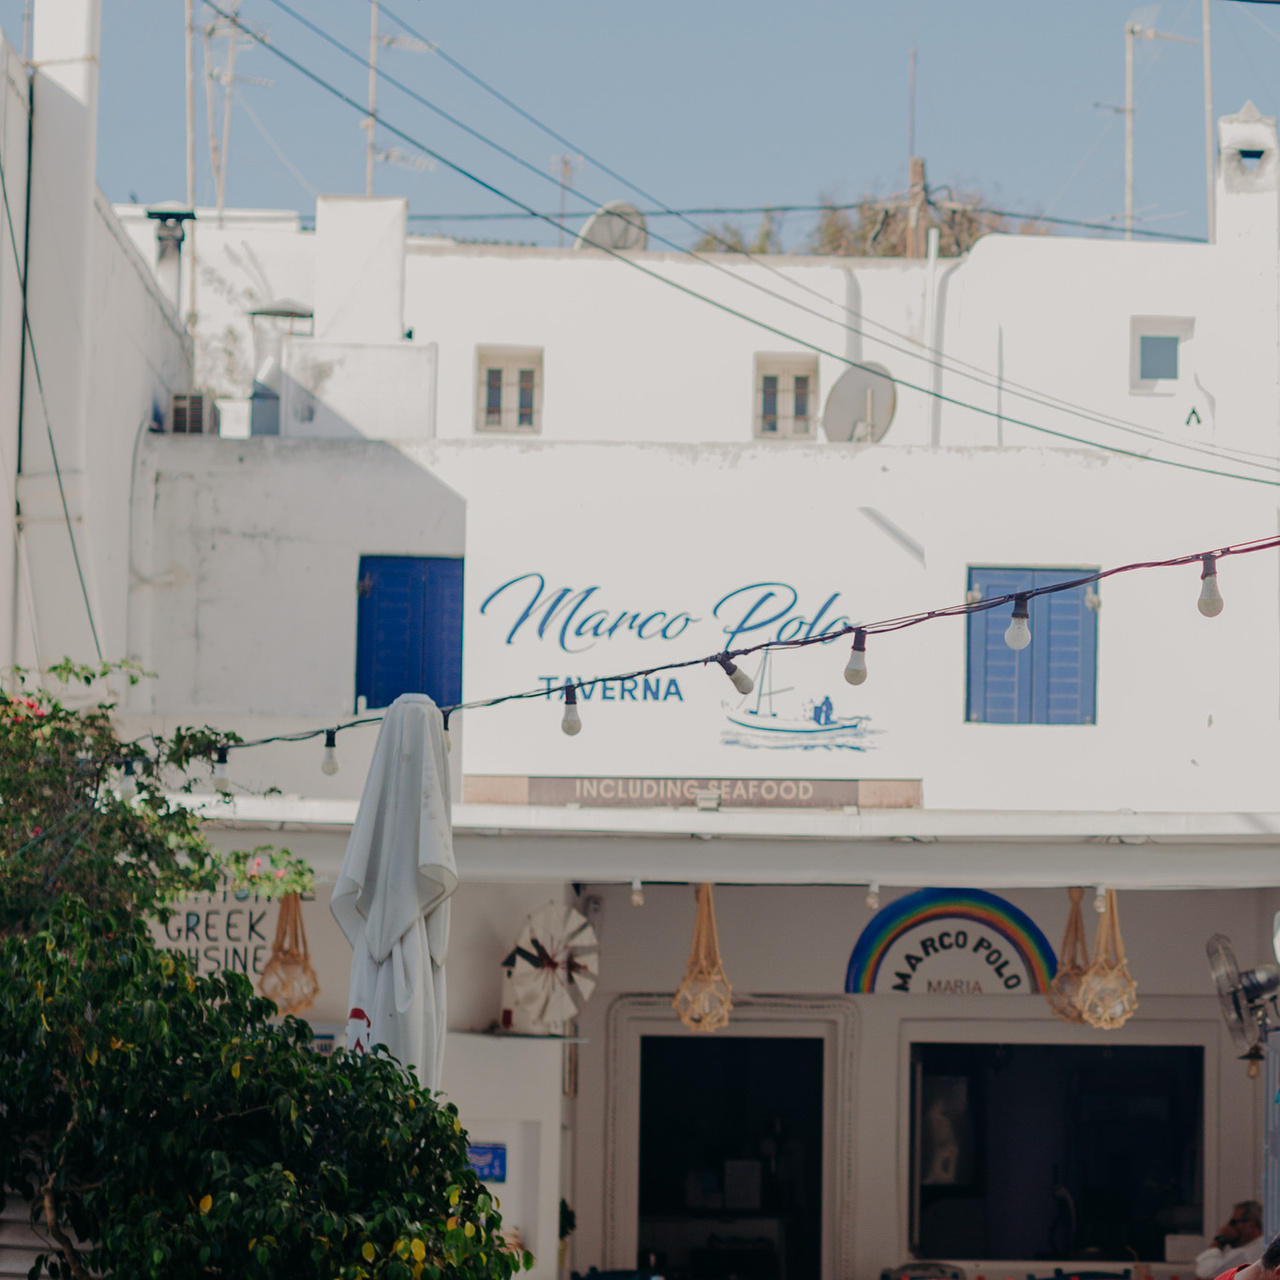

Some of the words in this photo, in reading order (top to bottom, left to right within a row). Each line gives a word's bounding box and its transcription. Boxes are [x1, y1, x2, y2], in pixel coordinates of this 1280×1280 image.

[479, 572, 702, 654] Marco
[712, 582, 860, 653] Polo
[538, 675, 684, 701] TAVERNA
[576, 778, 699, 799] INCLUDING
[165, 909, 267, 942] GREEK
[891, 930, 969, 992] MARCO
[972, 936, 1021, 990] POLO
[926, 979, 984, 994] MARIA
